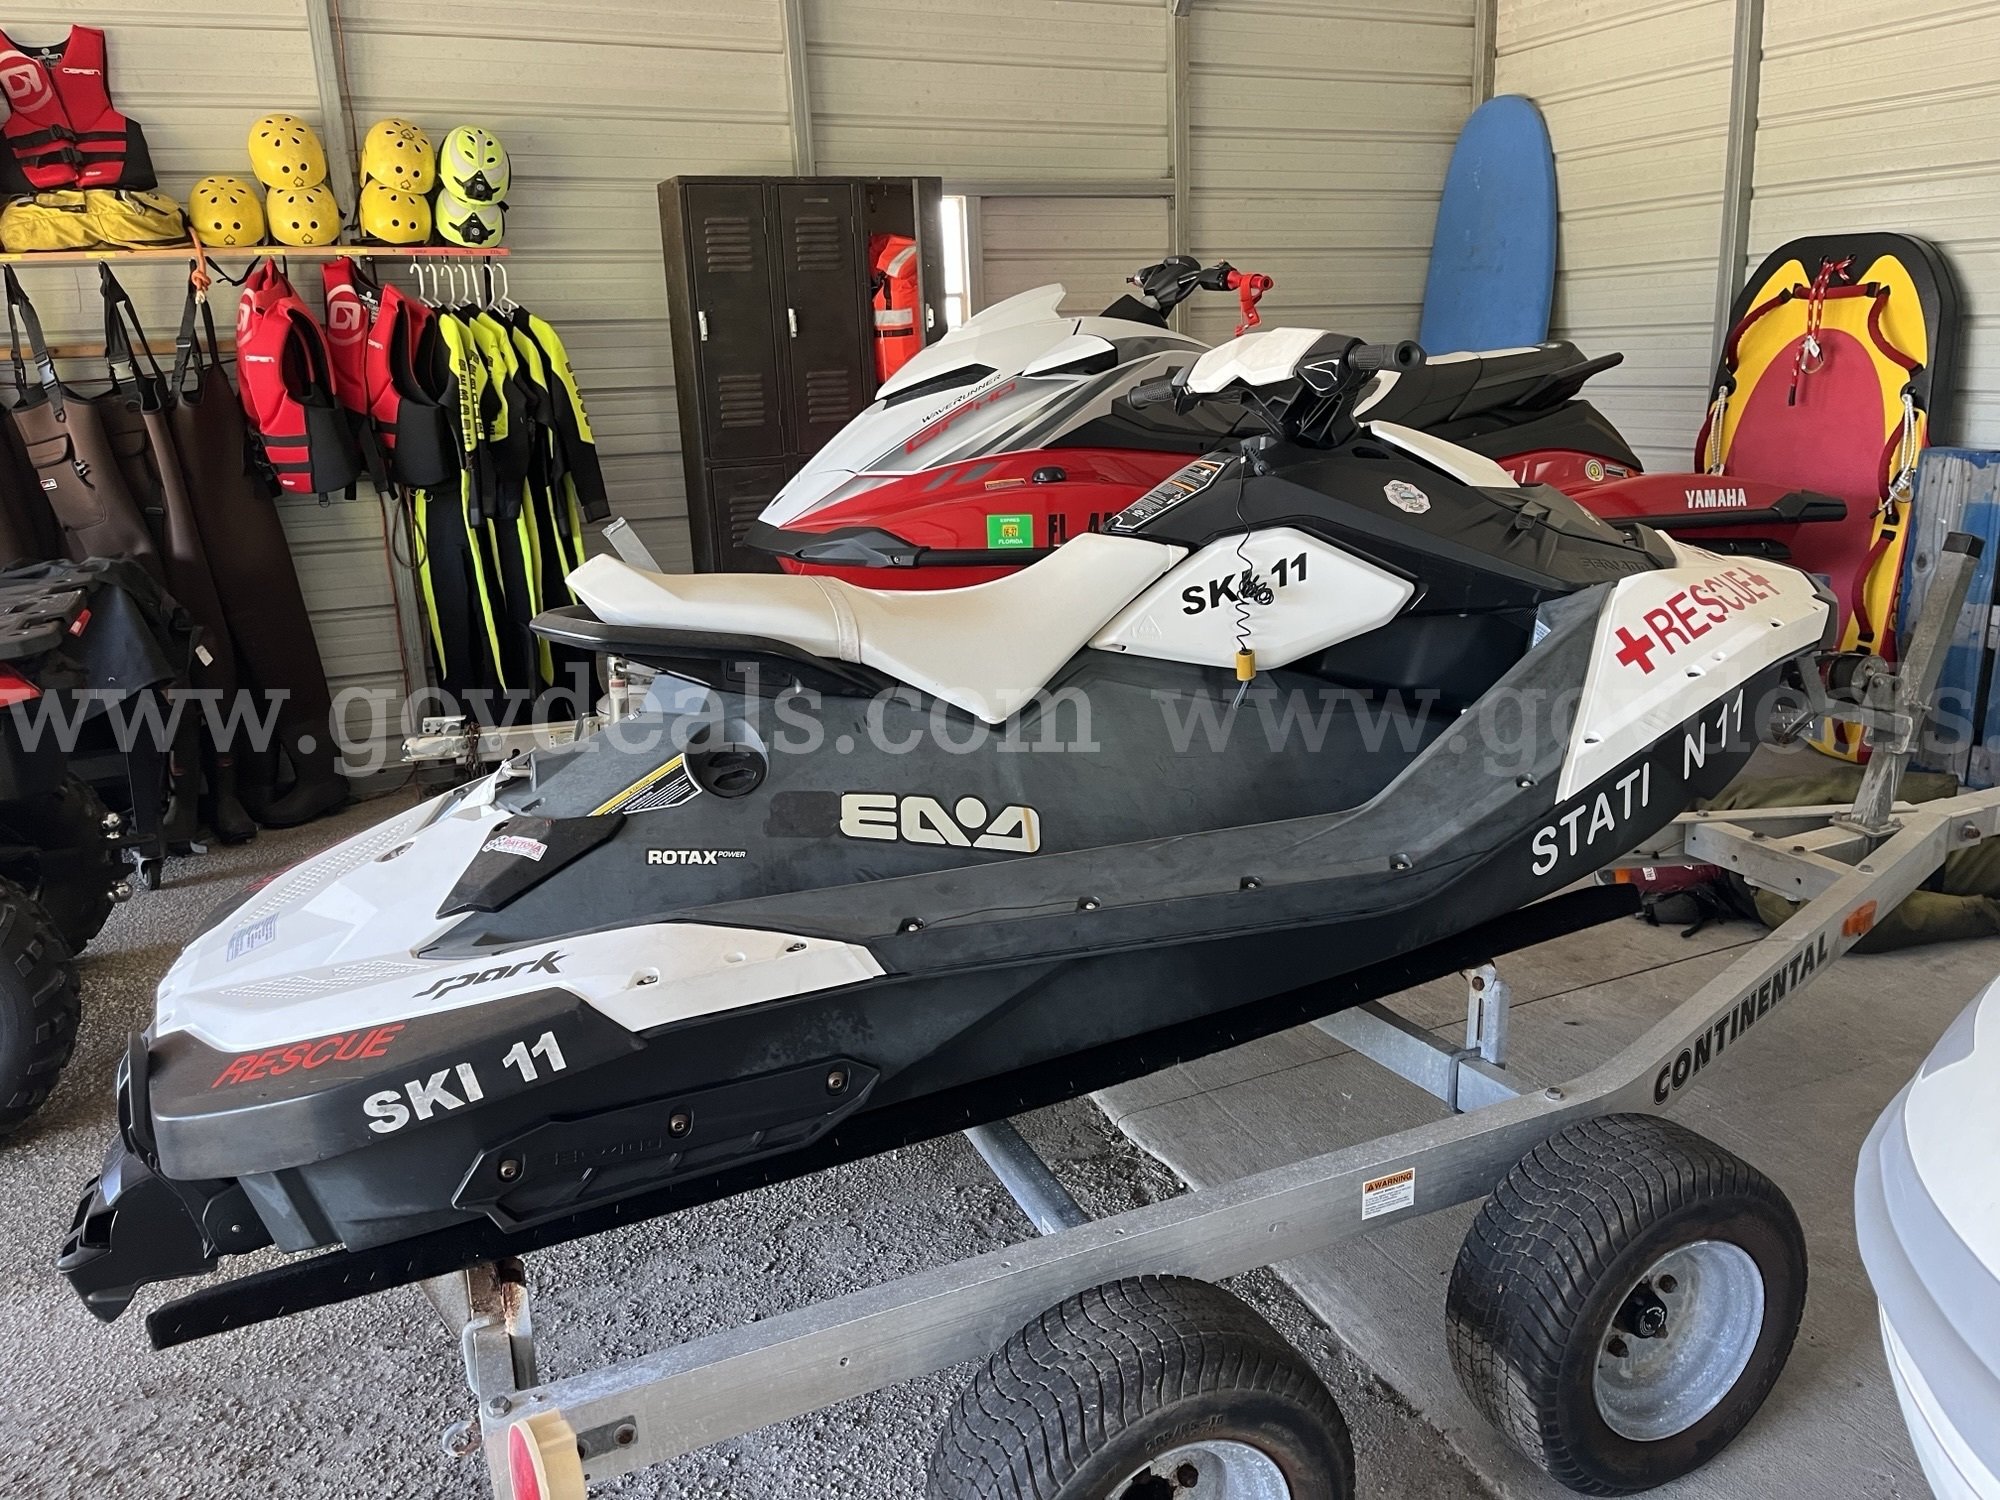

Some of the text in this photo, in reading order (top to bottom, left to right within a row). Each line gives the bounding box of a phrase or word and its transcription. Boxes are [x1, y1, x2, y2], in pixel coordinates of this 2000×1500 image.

[1685, 487, 1748, 509] YAMAHA
[1047, 513, 1066, 548] FL
[1270, 551, 1308, 589] 11
[1642, 570, 1769, 656] RESCUE
[1716, 688, 1744, 749] 11
[648, 850, 718, 865] ROTAX
[1654, 931, 1829, 1106] CONTINENTAL
[211, 1024, 406, 1089] RESCUE
[363, 1030, 567, 1134] SKI 11
[1374, 1172, 1412, 1190] WARNING
